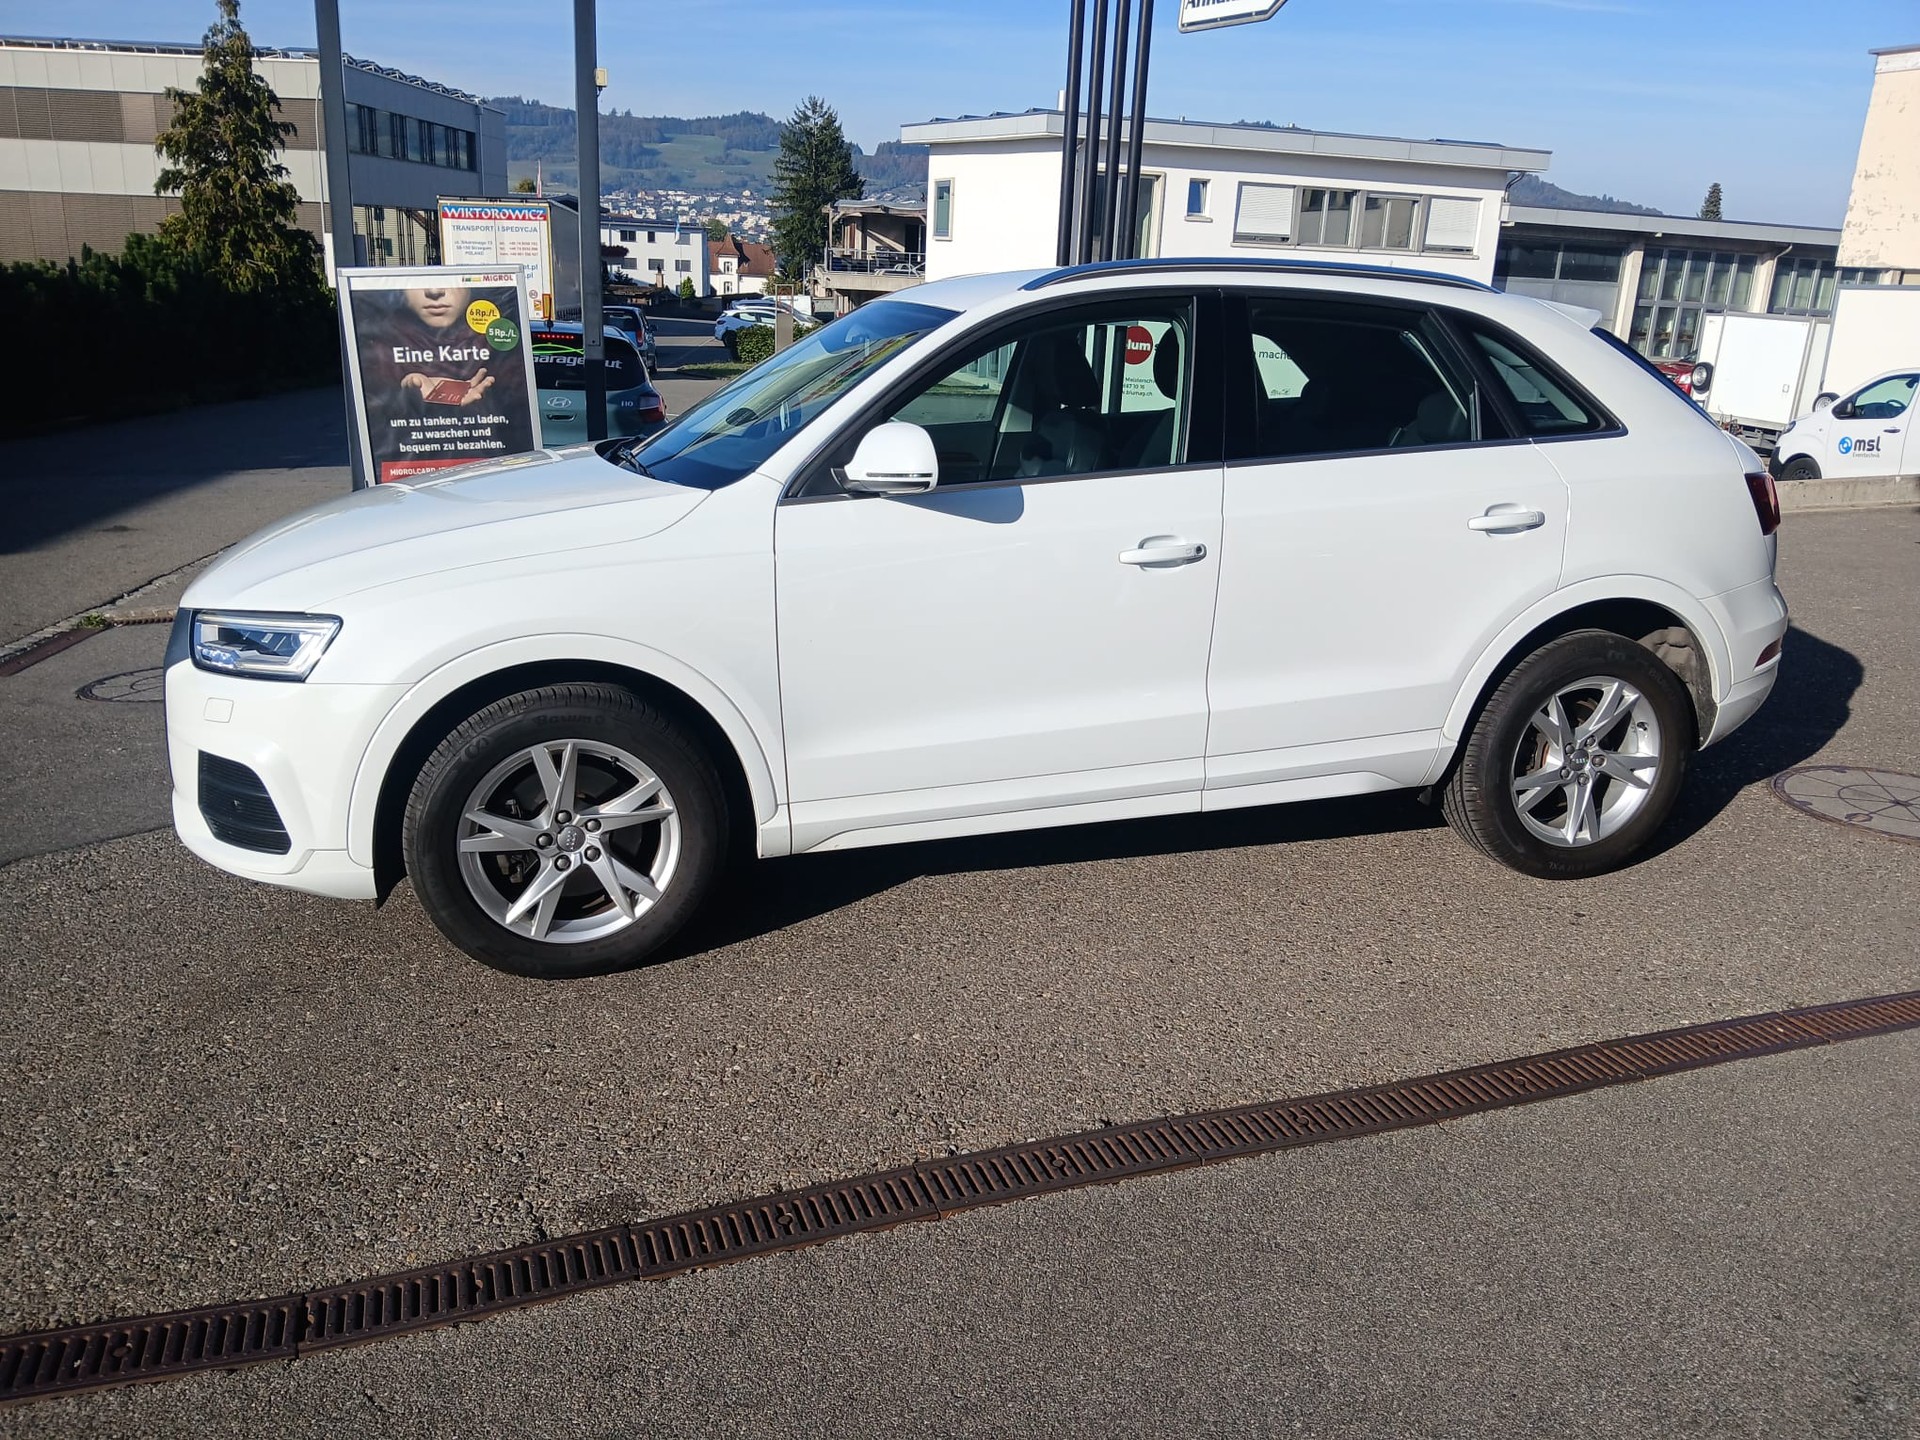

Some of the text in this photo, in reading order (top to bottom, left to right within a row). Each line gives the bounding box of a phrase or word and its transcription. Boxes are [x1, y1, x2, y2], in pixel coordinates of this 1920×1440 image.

[443, 207, 545, 220] WIKTOROWICZ
[482, 274, 514, 282] MIGROL
[475, 309, 498, 317] Rp./L
[488, 328, 517, 338] 5 Rp./L
[1125, 339, 1151, 351] lum
[393, 345, 490, 363] Eine Karte
[533, 355, 585, 367] arage
[1125, 377, 1156, 385] Meistersch
[390, 414, 509, 427] um zu tanken, zu laden,
[411, 427, 492, 439] zu waschen und
[399, 440, 506, 454] bequem zu bezahlen.
[1853, 435, 1881, 452] msl
